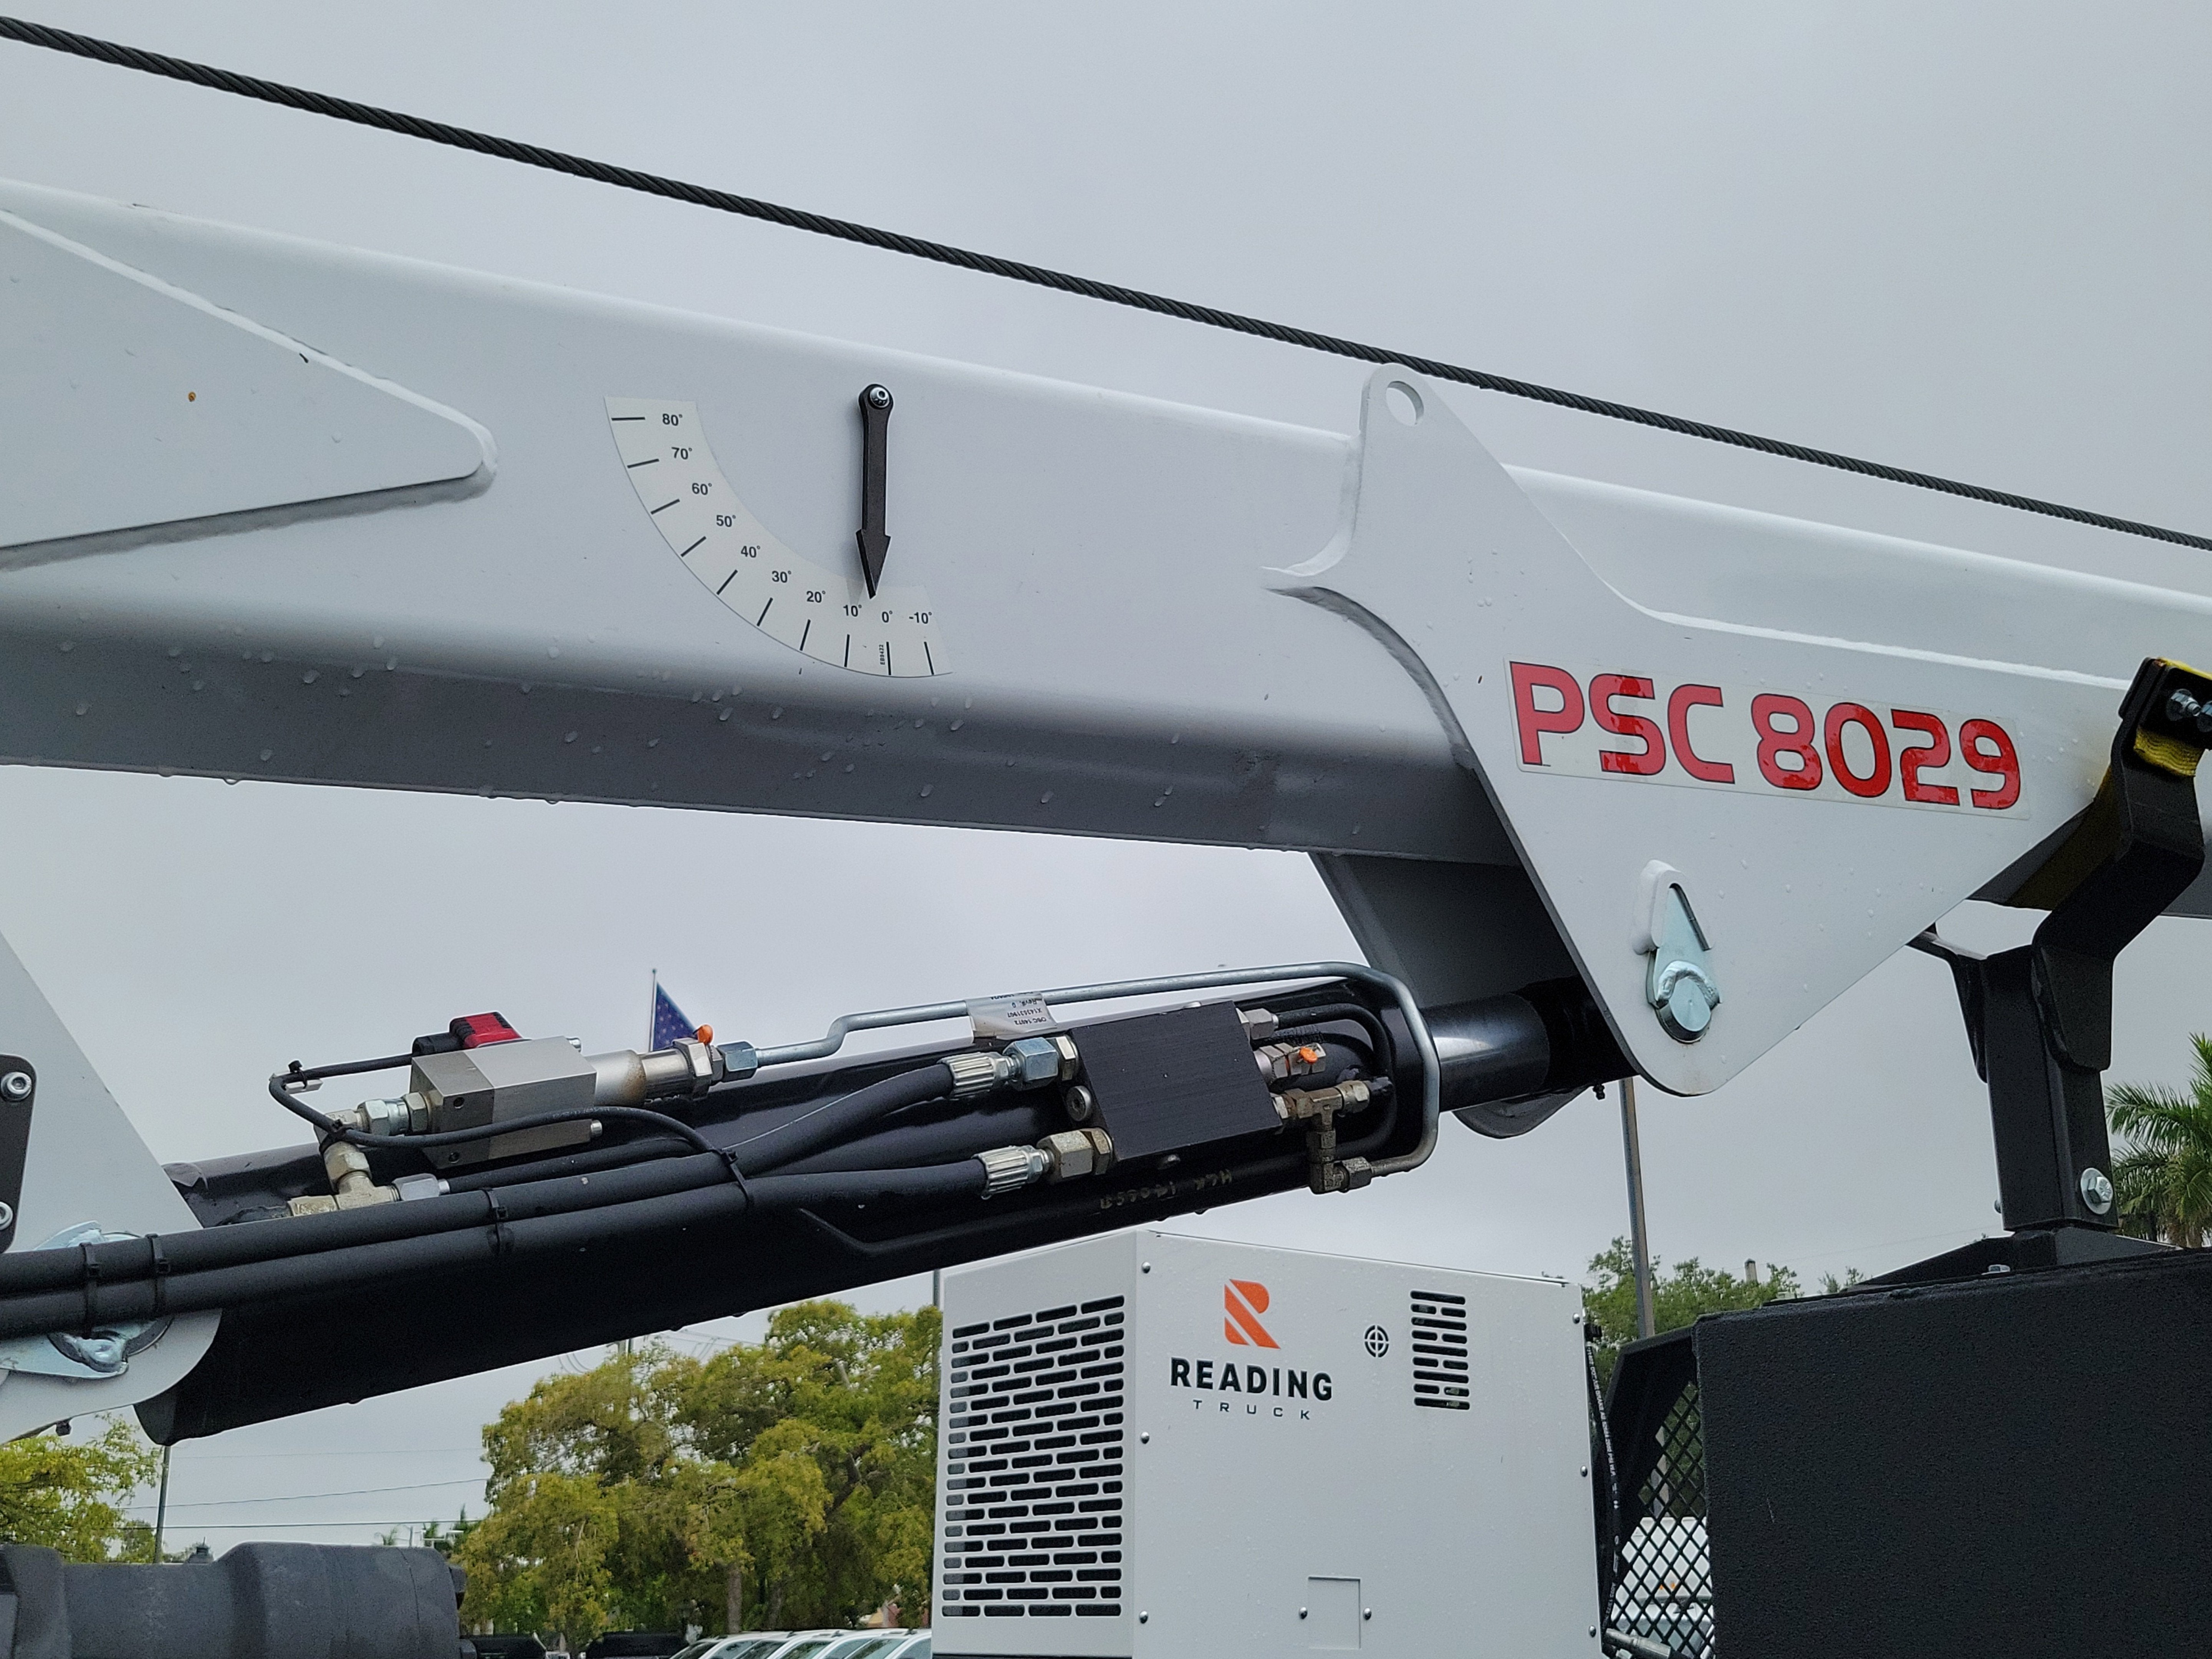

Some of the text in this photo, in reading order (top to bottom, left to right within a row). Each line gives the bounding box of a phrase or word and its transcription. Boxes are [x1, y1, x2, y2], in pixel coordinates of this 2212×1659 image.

[662, 413, 683, 426] 80°
[671, 447, 692, 460] 70°
[692, 483, 712, 495] 60°
[716, 515, 736, 527] 50°
[741, 545, 760, 558] 40°
[772, 570, 791, 583] 30°
[806, 590, 826, 603] 20°
[843, 604, 862, 617] 10°
[881, 610, 893, 623] 0°
[909, 612, 932, 624] -10°
[1510, 661, 2021, 810] PSC 8029
[1171, 1357, 1332, 1401] READING
[1193, 1399, 1310, 1420] TRUCK
